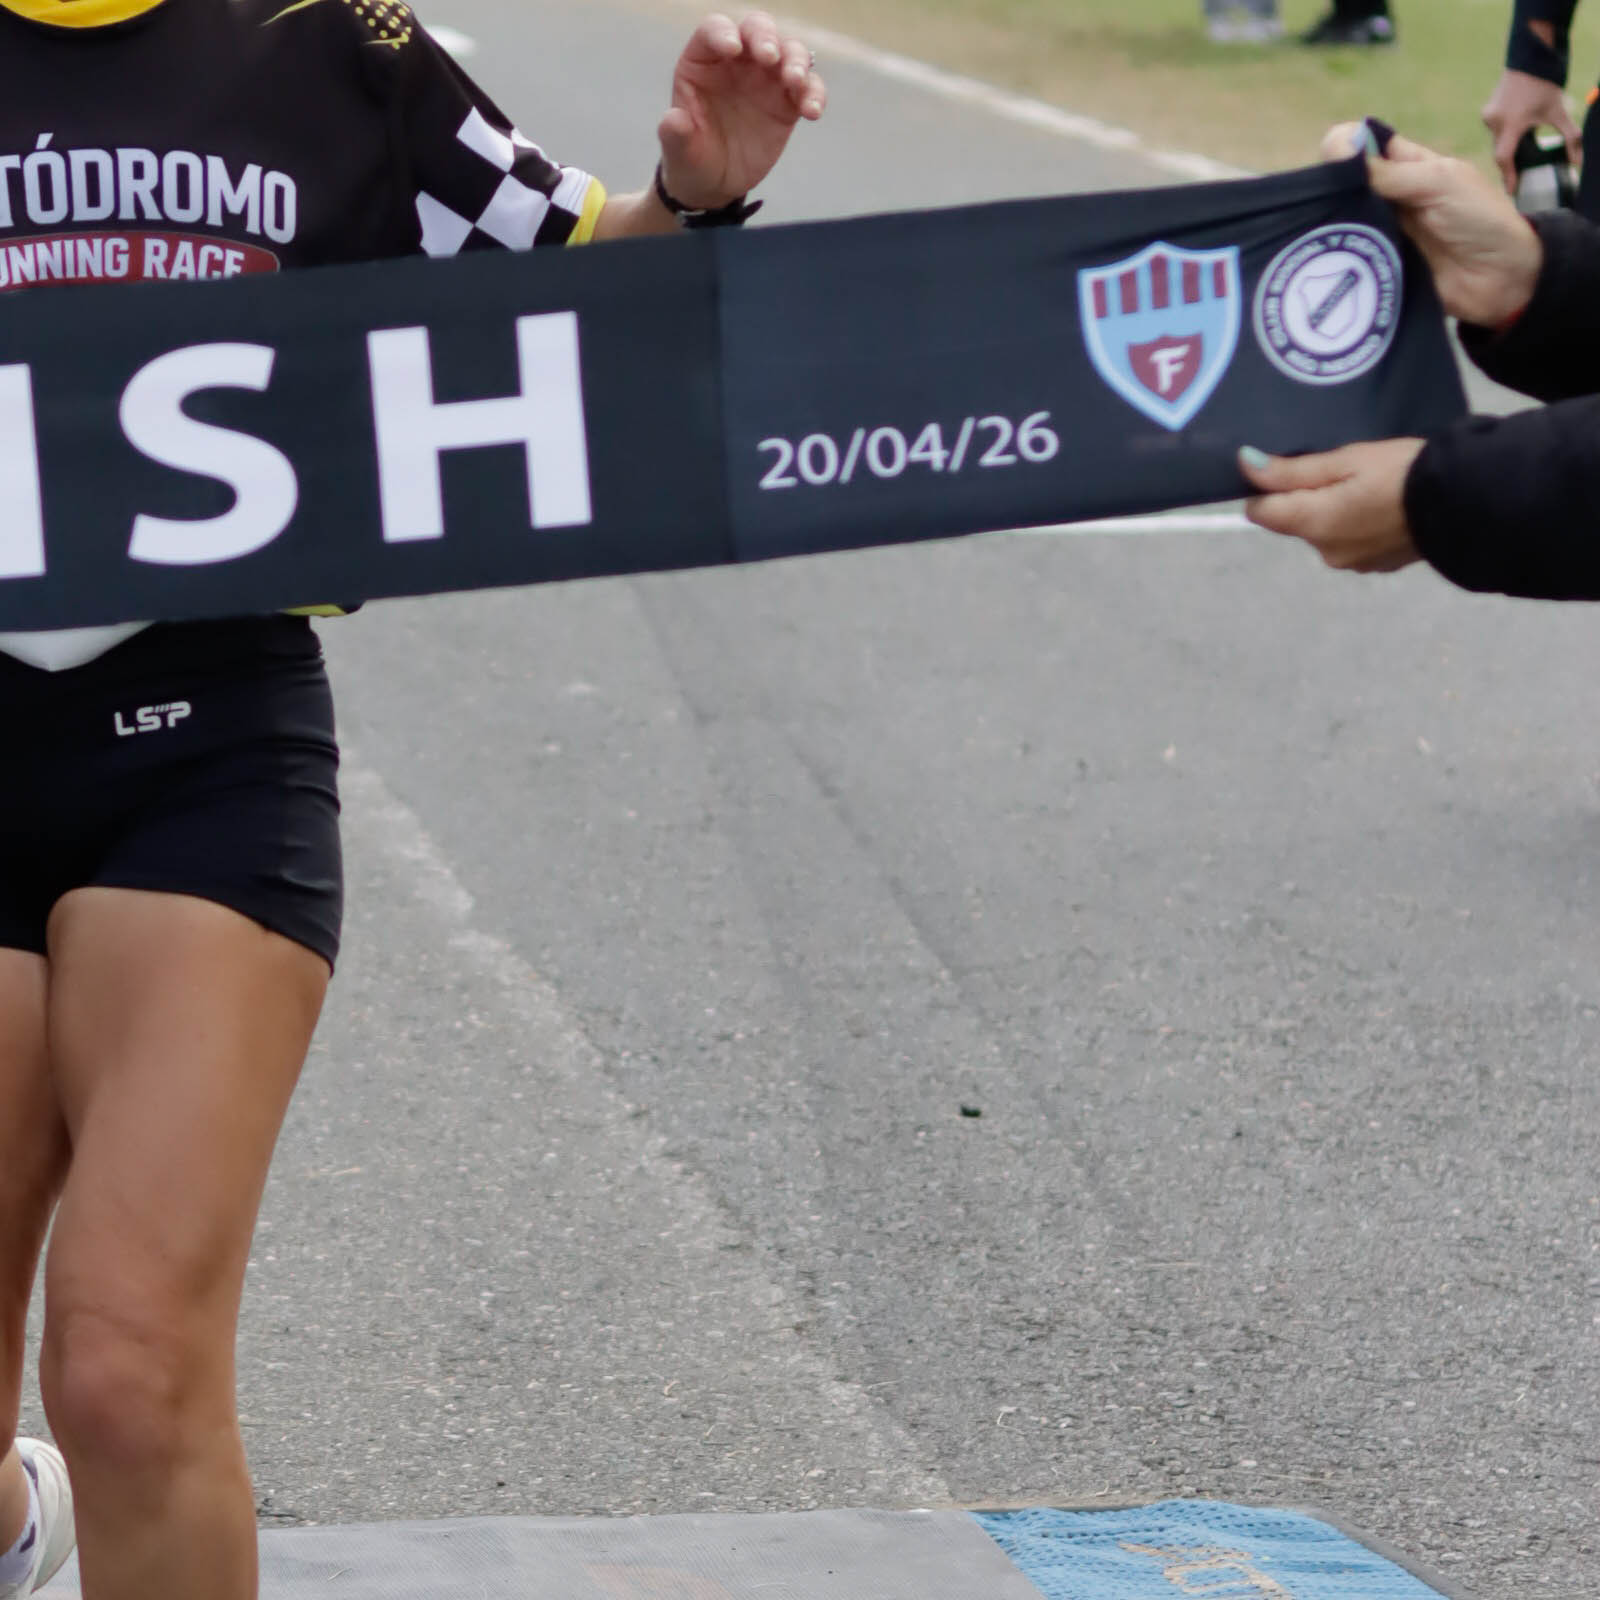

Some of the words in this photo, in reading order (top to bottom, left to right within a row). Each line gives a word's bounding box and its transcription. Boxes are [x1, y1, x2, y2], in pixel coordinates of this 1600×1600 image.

[142, 237, 245, 281] RACE
[756, 410, 1060, 490] 20/04/26
[114, 700, 192, 736] LSP
